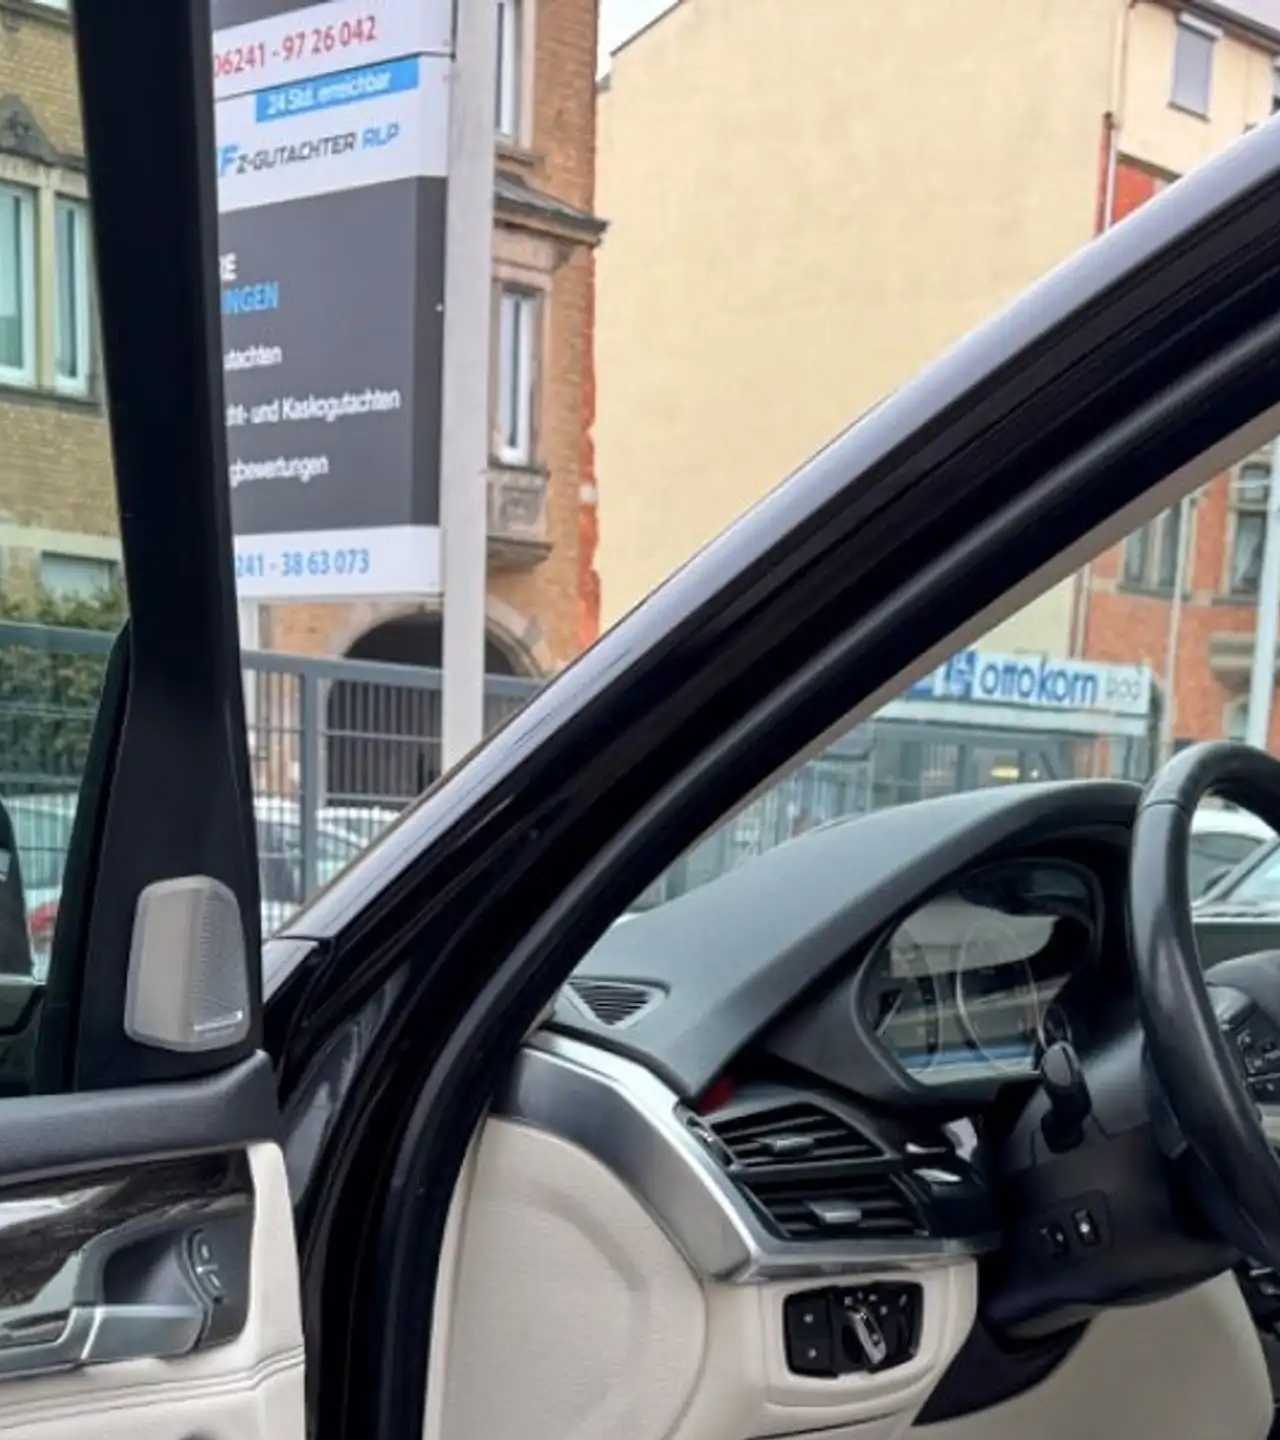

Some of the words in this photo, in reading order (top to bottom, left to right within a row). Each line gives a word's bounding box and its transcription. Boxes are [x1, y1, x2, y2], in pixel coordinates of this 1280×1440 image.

[282, 31, 306, 61] 97
[311, 24, 335, 53] 26
[339, 15, 377, 47] 042
[362, 122, 400, 149] RLP
[250, 398, 280, 424] und
[280, 550, 304, 578] 38
[306, 548, 332, 576] 63
[334, 547, 371, 575] 073
